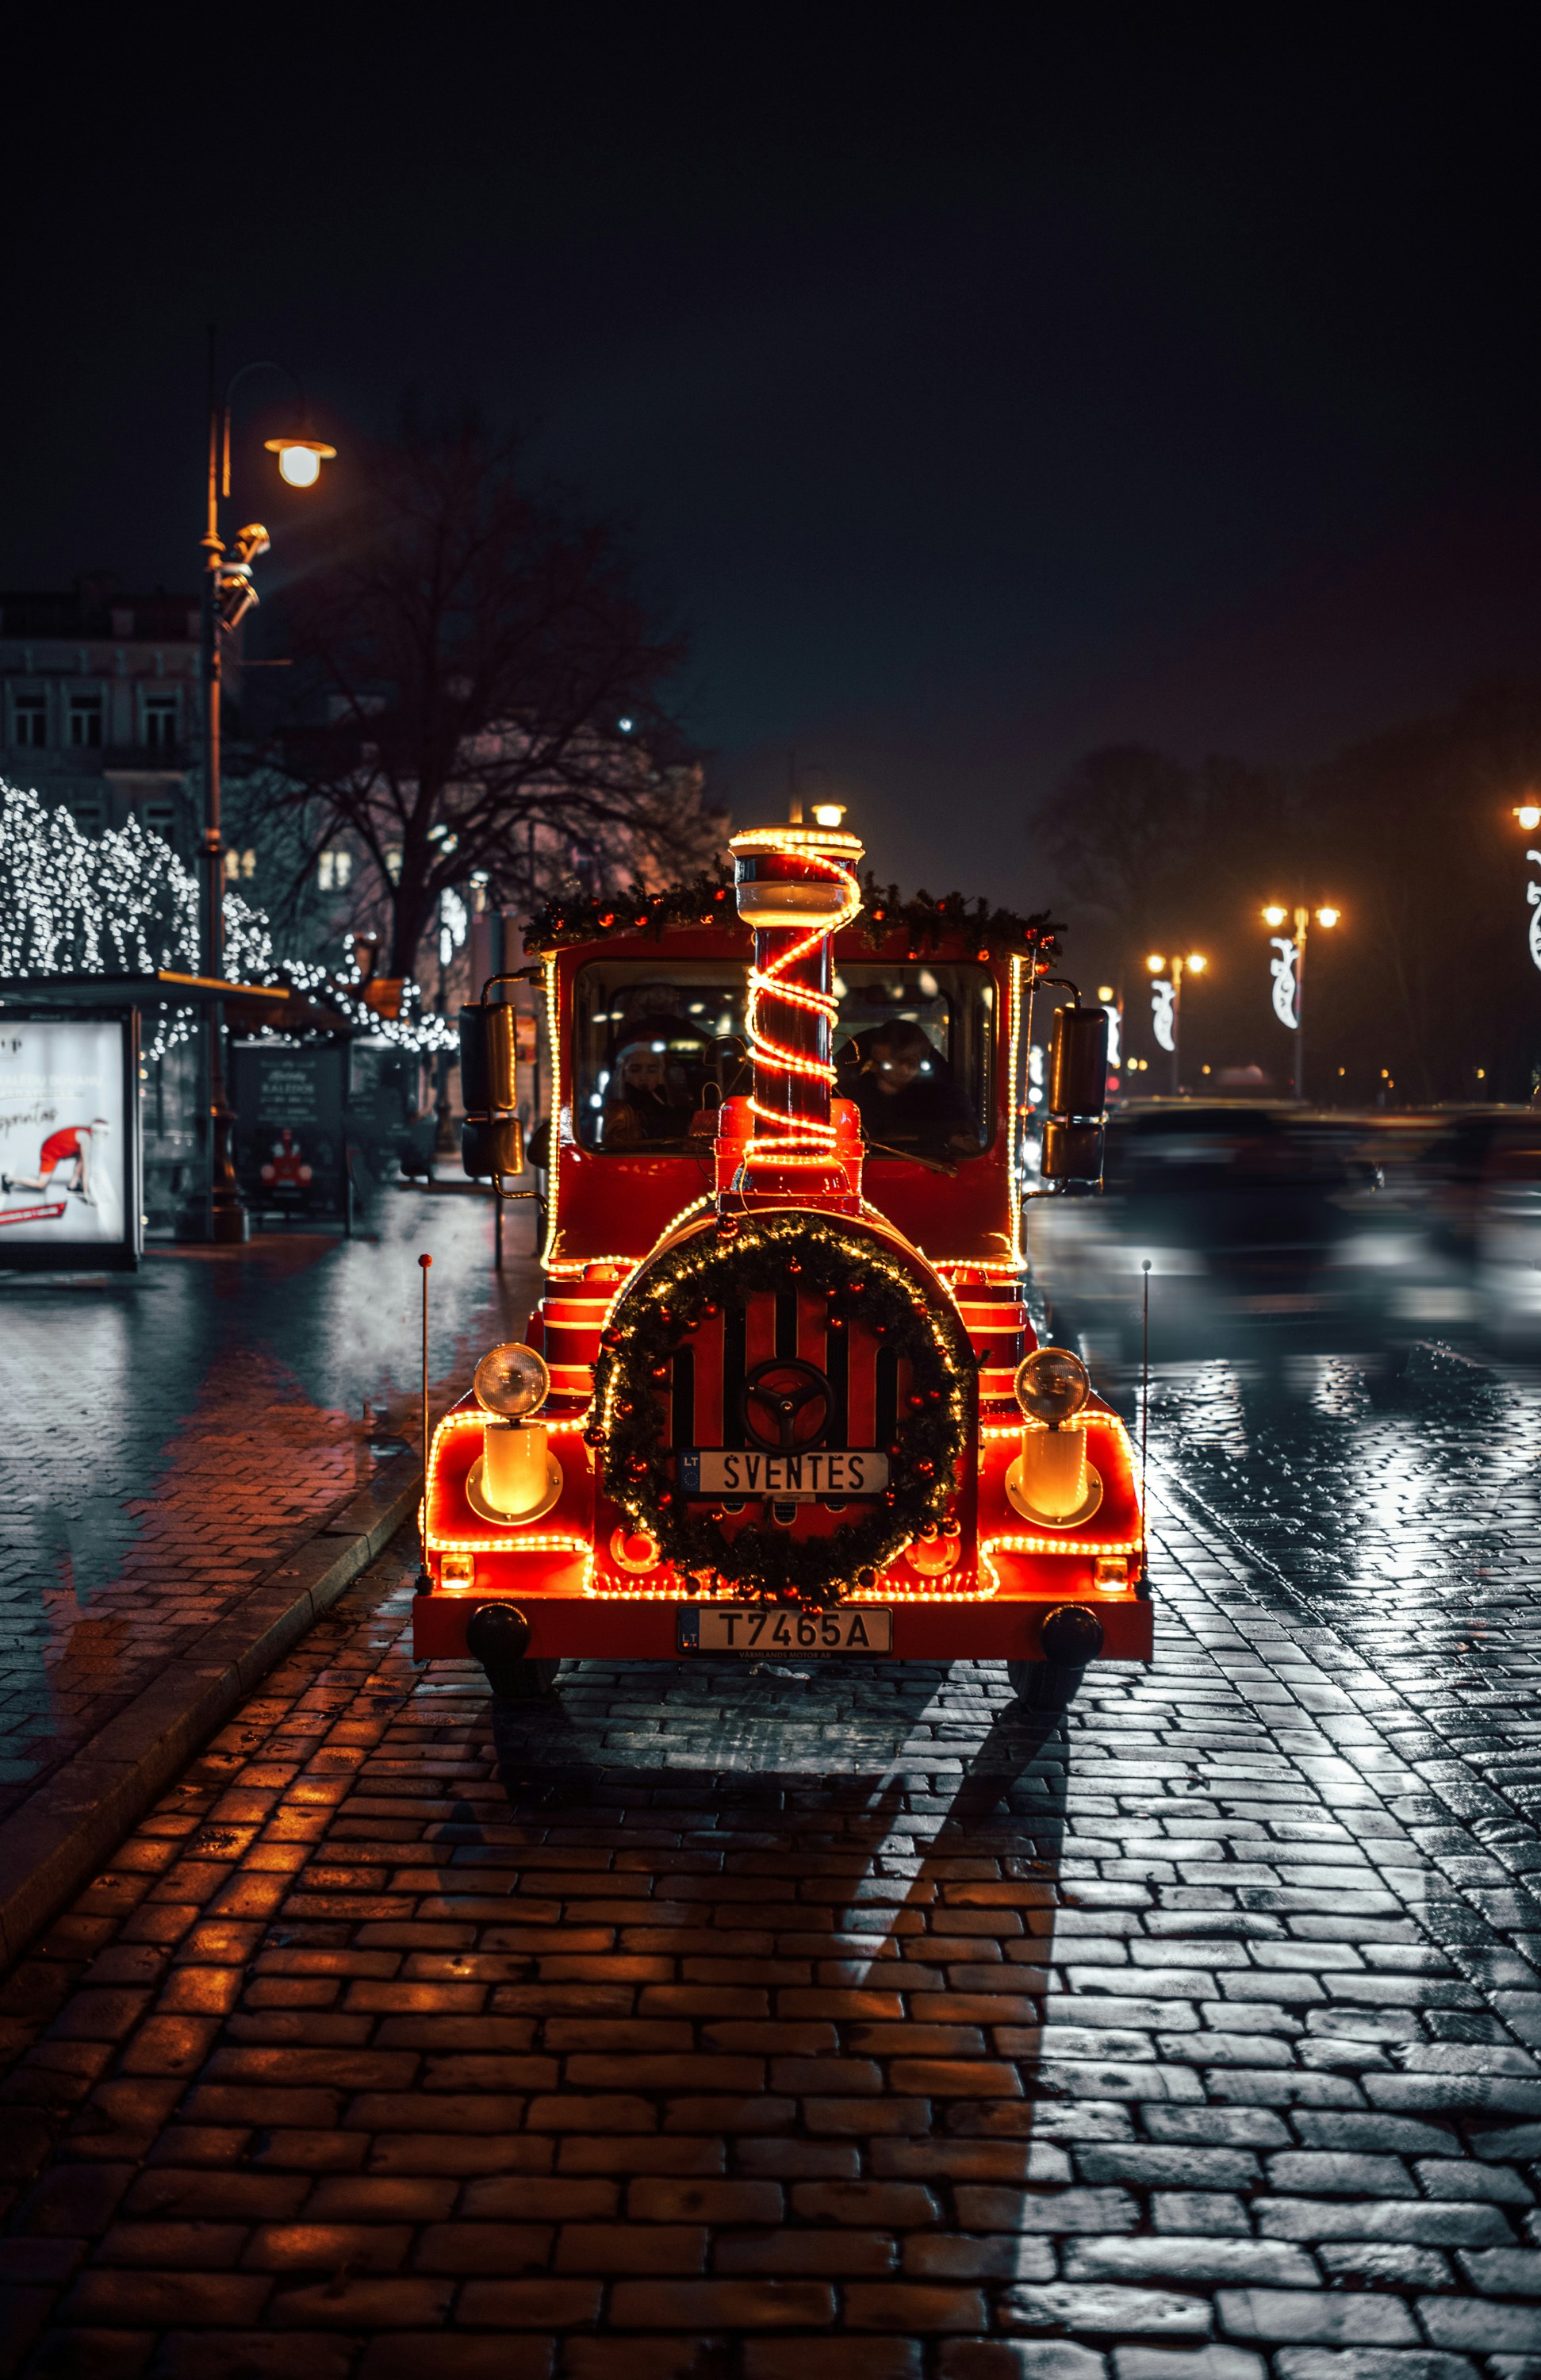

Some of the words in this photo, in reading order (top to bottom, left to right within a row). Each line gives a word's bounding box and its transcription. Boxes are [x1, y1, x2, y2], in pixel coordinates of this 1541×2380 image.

[684, 1457, 699, 1467] LT
[719, 1613, 870, 1647] T7465A
[681, 1633, 697, 1643] LT
